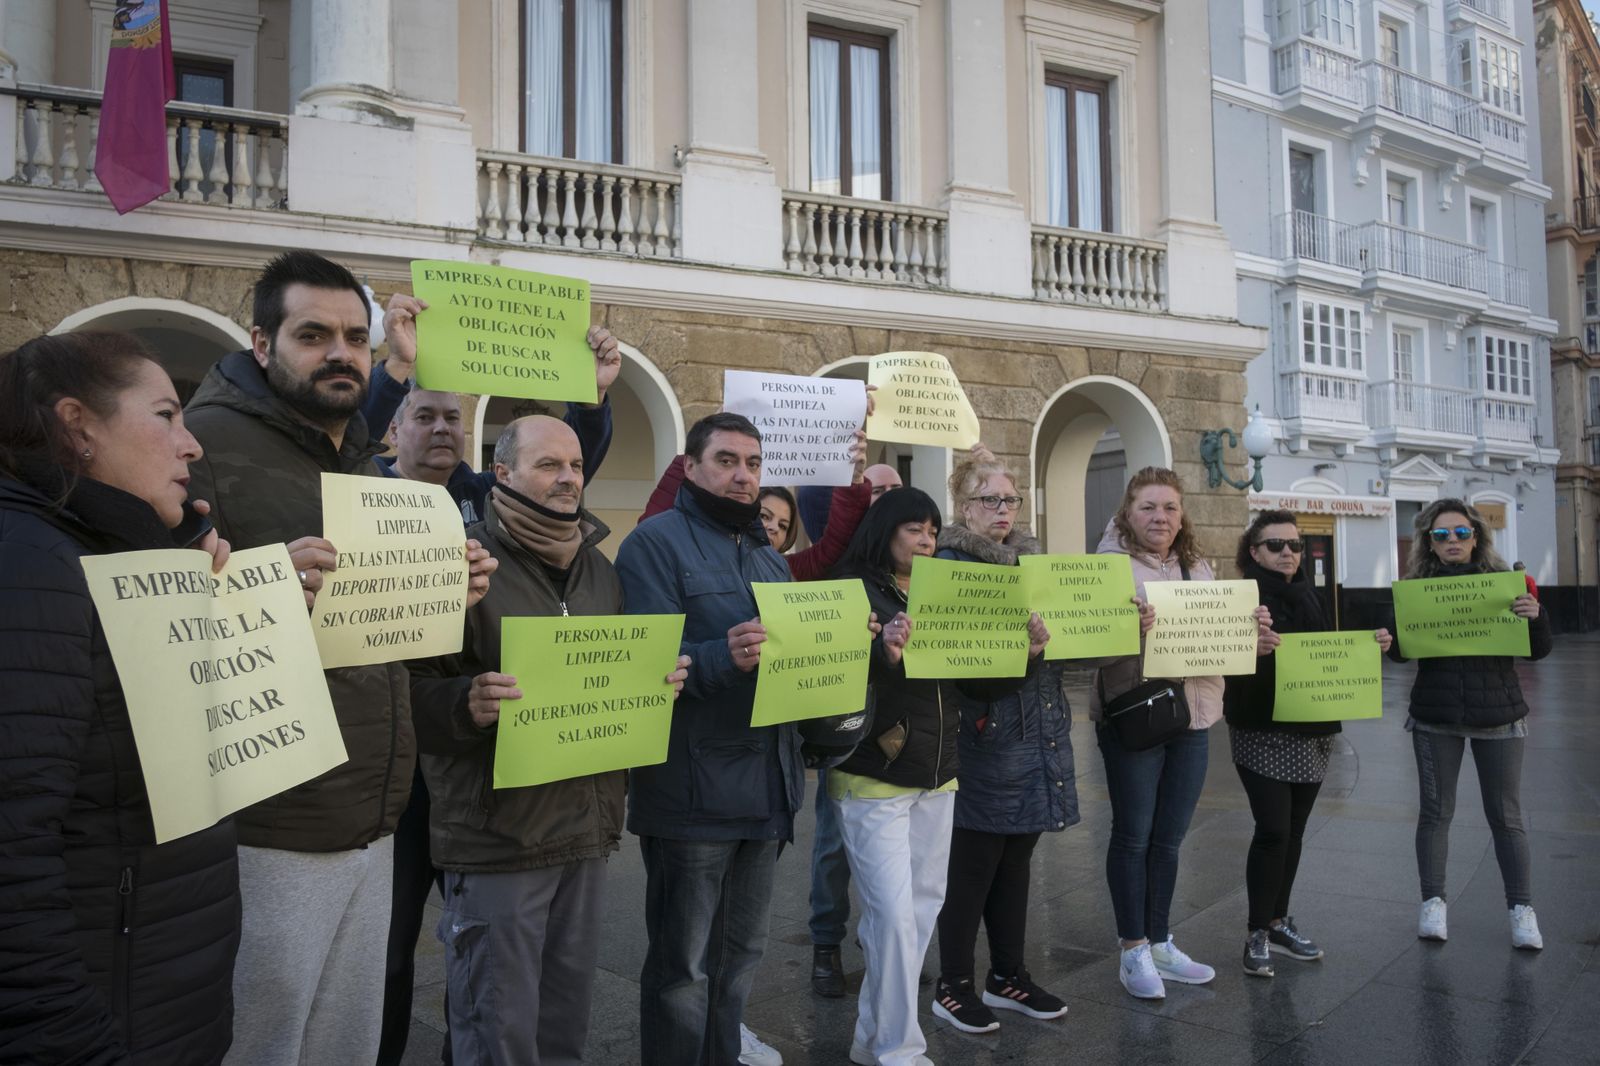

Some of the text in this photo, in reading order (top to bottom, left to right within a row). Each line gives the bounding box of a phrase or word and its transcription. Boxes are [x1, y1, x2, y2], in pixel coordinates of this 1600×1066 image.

[425, 270, 585, 302] EMPRESA CULPABLE
[449, 294, 566, 321] AYTO TIENE LA
[459, 316, 556, 340] OBLIGACIÓN
[467, 340, 552, 362] DE BUSCAR
[876, 359, 928, 369] EMPRESA
[462, 360, 560, 382] SOLUCIONES
[890, 374, 920, 383] AYTO
[922, 376, 952, 387] TIENE
[761, 382, 836, 396] PERSONAL DE
[896, 389, 960, 402] OBLIGACIÓN
[773, 400, 826, 412] LIMPIEZA
[899, 405, 956, 418] DE BUSCAR
[753, 416, 857, 430] LAS INTALACIONES
[893, 420, 959, 432] SOLUCIONES
[807, 436, 822, 444] DE
[824, 433, 852, 445] CÁDIZ
[762, 451, 852, 462] OBRAR NUESTRAS
[767, 465, 816, 477] NÓMINAS
[361, 492, 436, 508] PERSONAL DE
[1307, 500, 1324, 510] BAR
[377, 520, 432, 536] LIMPIEZA
[338, 546, 463, 569] EN LAS INTALACIONES
[1051, 562, 1110, 572] PERSONAL DE
[330, 568, 464, 598] DEPORTIVAS DE CÁDIZ
[951, 571, 1022, 584] PERSONAL DE
[1060, 577, 1103, 586] LIMPIEZA
[1174, 587, 1234, 596] PERSONAL DE
[1424, 580, 1495, 593] PERSONAL DE
[783, 590, 845, 604] PERSONAL DE
[957, 588, 1007, 600] LIMPIEZA
[1073, 593, 1092, 602] IMD
[1435, 593, 1486, 604] LIMPIEZA
[920, 605, 1031, 617] EN LAS INTALACIONES
[1185, 601, 1227, 610] LIMPIEZA
[1452, 607, 1472, 615] IMD
[321, 599, 462, 628] SIN COBRAR NUESTRAS
[799, 609, 842, 623] LIMPIEZA
[1089, 608, 1134, 618] NUESTROS
[236, 607, 278, 634] LA
[916, 620, 1027, 632] DEPORTIVAS DE CÁDIZ
[1157, 616, 1255, 626] EN LAS INTALACIONES
[1405, 617, 1522, 632] ¡QUEREMOS NUESTROS
[554, 627, 649, 644] PERSONAL DE
[1062, 625, 1111, 636] SALARIOS!
[1156, 631, 1212, 640] DEPORTIVAS
[1214, 630, 1224, 638] DE
[1438, 630, 1492, 641] SALARIOS!
[362, 628, 424, 649] NÓMINAS
[816, 632, 832, 644] IMD
[1301, 638, 1355, 648] PERSONAL DE
[912, 640, 1026, 650] SIN COBRAR NUESTRAS
[1154, 644, 1254, 655] SIN COBRAR NUESTRAS
[566, 650, 632, 666] LIMPIEZA
[768, 649, 868, 674] ¡QUEREMOS NUESTROS
[946, 654, 993, 666] NÓMINAS
[1309, 651, 1349, 660] LIMPIEZA
[1185, 658, 1226, 668] NÓMINAS
[1322, 665, 1339, 673] IMD
[583, 676, 610, 690] IMD
[797, 674, 845, 691] SALARIOS!
[1284, 677, 1378, 691] ¡QUEREMOS NUESTROS
[1311, 693, 1355, 702] SALARIOS!
[513, 694, 668, 727] ¡QUEREMOS NUESTROS
[558, 723, 628, 744] SALARIOS!
